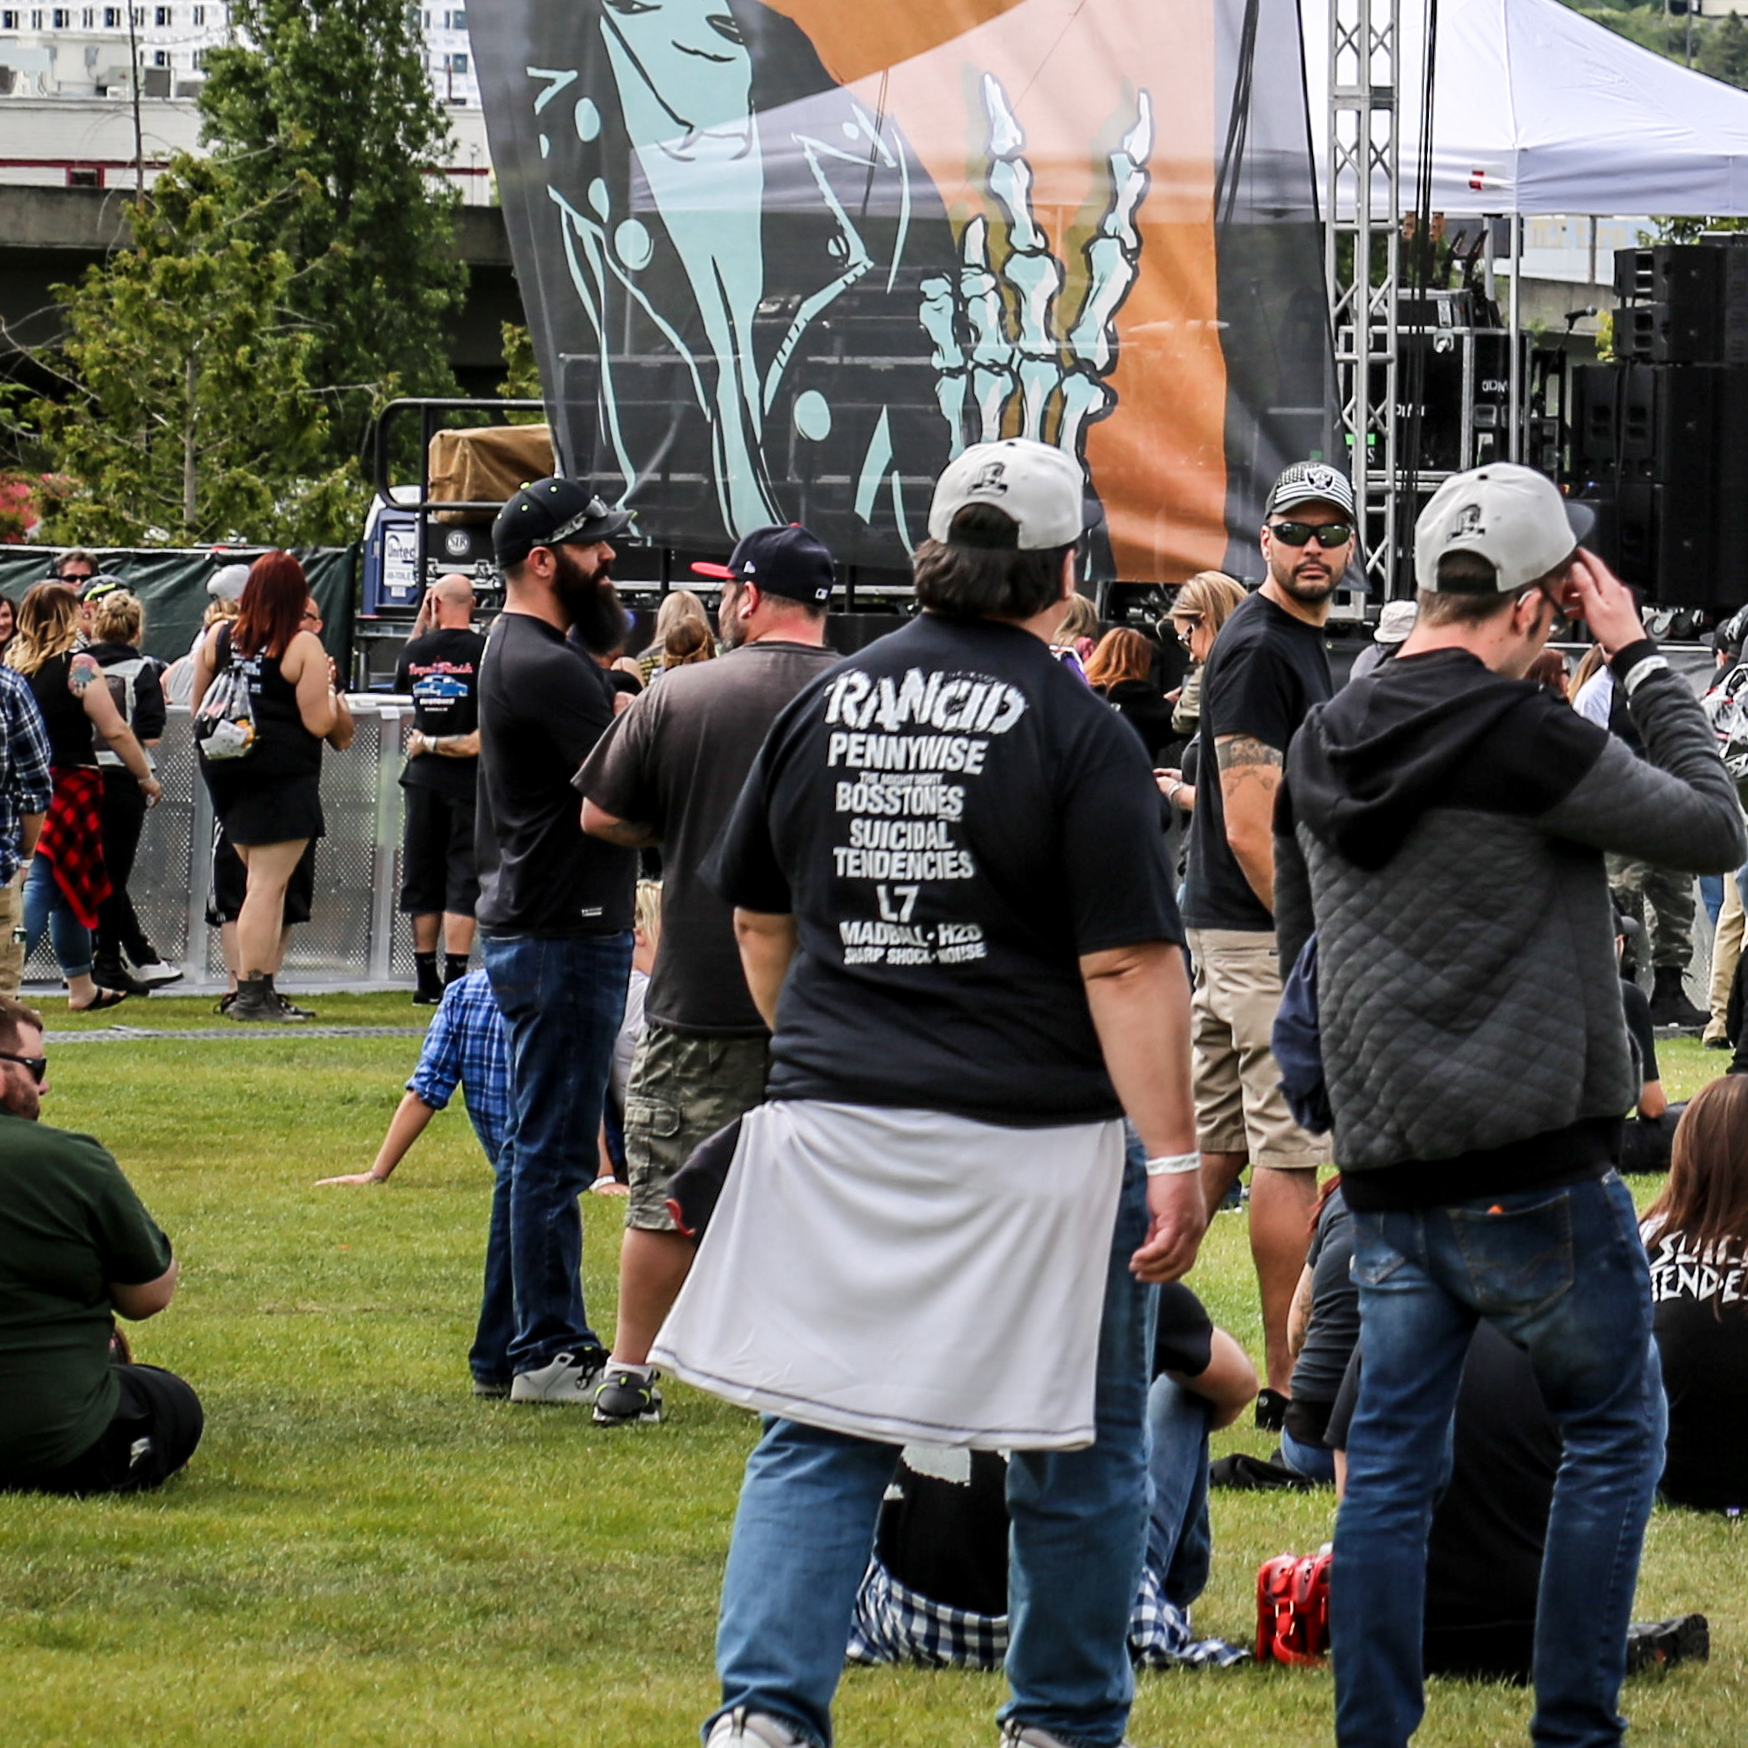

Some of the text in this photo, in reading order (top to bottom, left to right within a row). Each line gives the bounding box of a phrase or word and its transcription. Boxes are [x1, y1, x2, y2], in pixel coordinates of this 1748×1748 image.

[824, 667, 1028, 735] RANCID
[827, 732, 990, 775] PENNYWISE
[835, 781, 965, 817] BOSSTONES
[850, 818, 955, 850] SUICIDAL
[832, 847, 976, 880] TENDENCIES
[876, 884, 920, 923] L7
[839, 921, 929, 947] MADBALL
